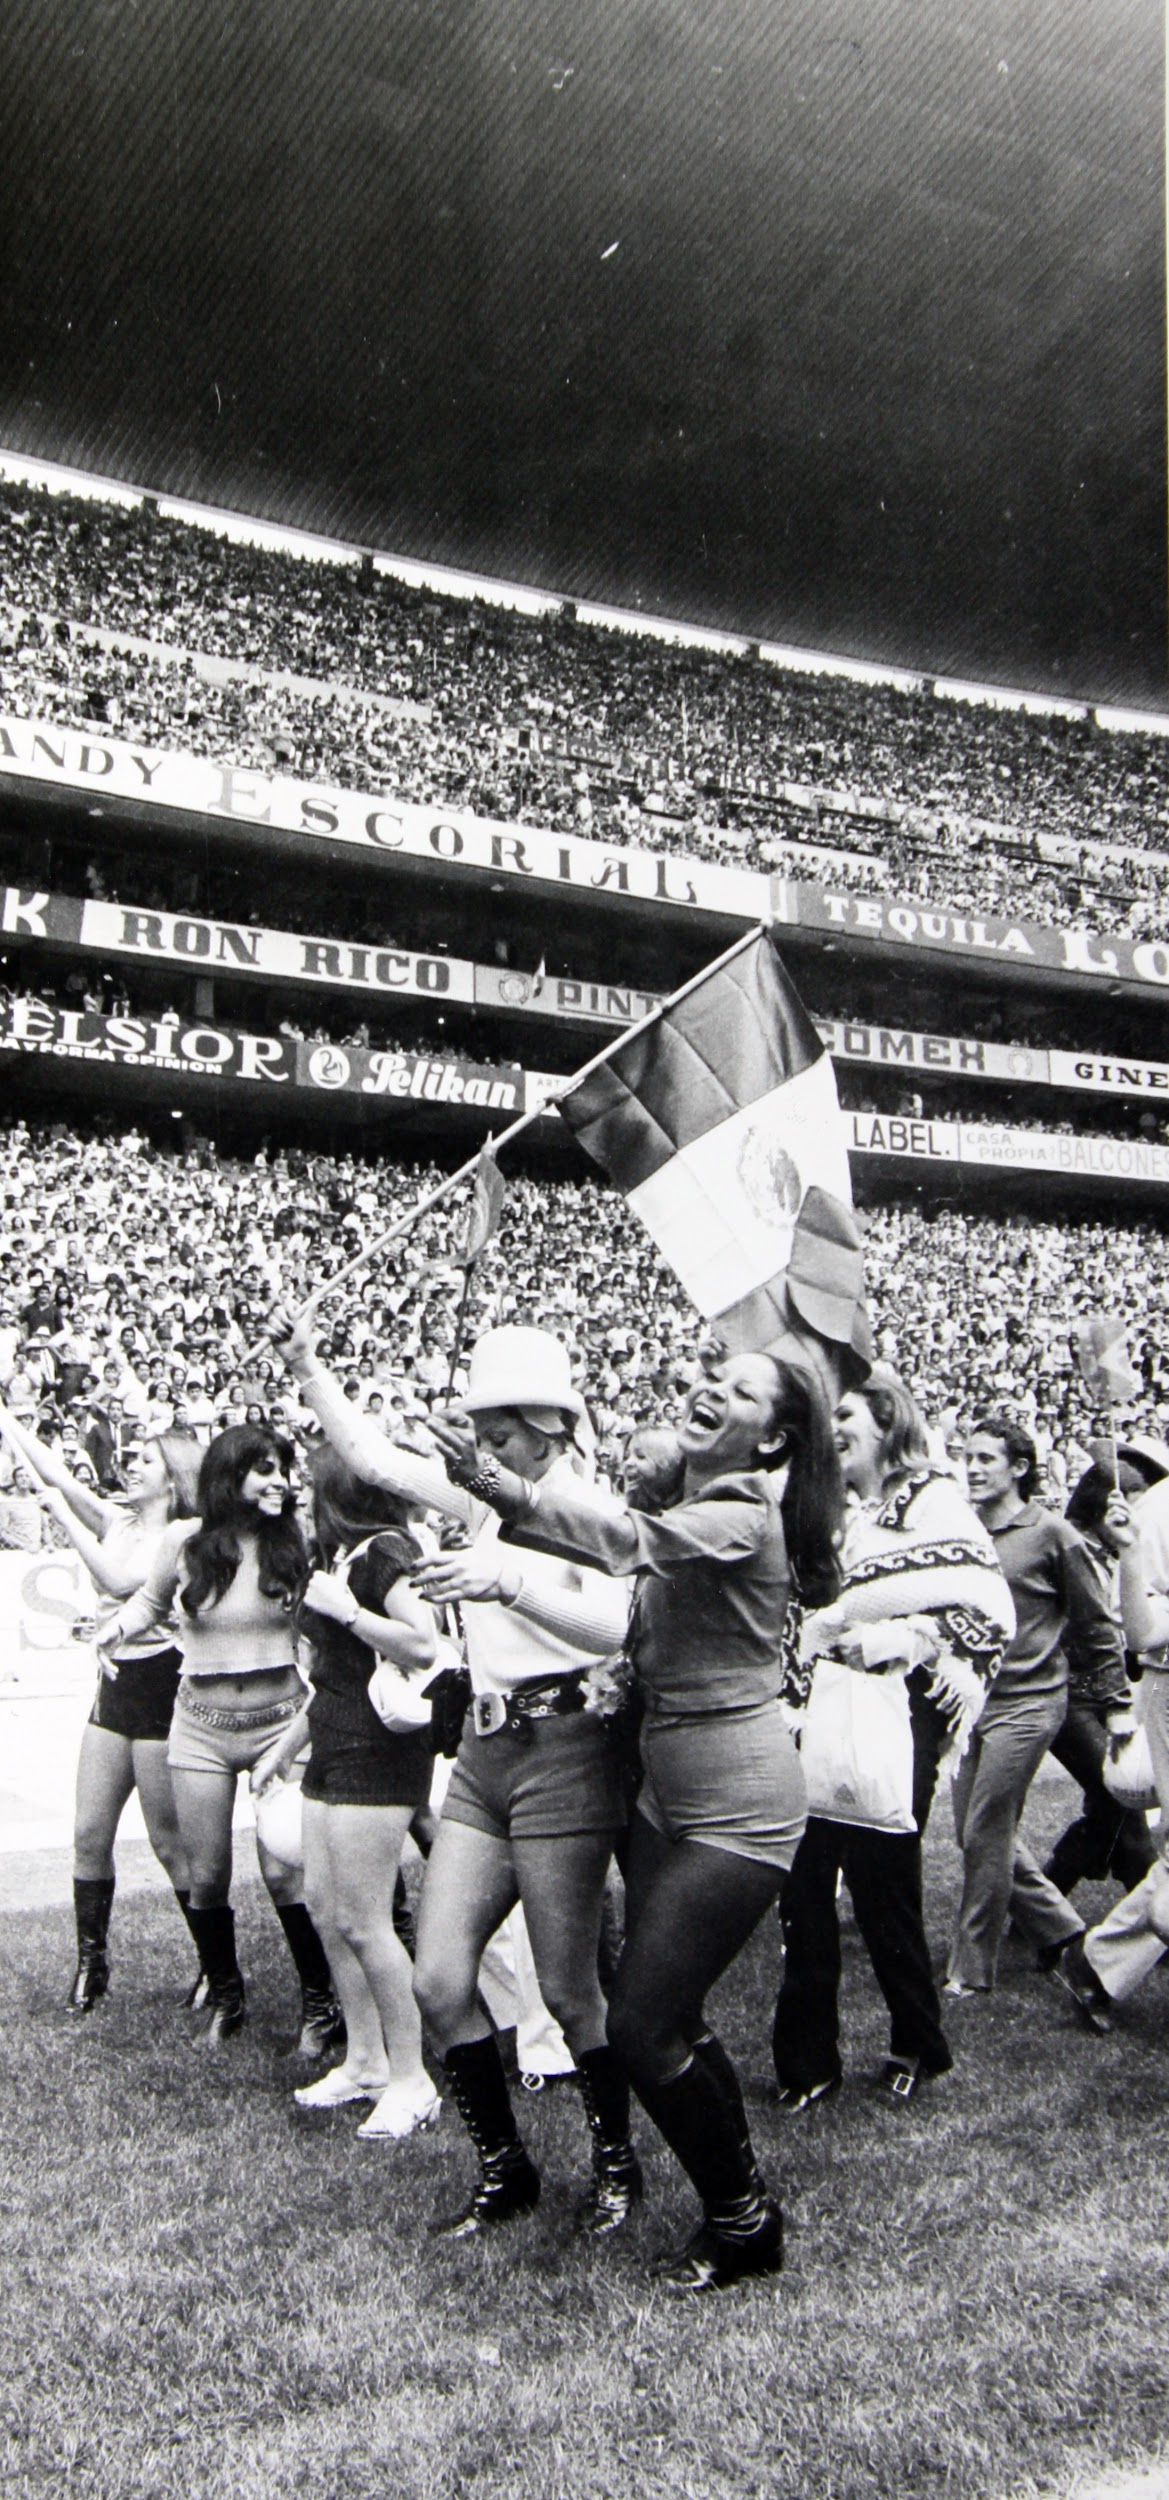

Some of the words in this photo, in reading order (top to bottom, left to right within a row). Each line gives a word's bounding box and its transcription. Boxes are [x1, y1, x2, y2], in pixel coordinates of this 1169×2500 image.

[207, 763, 697, 905] ESCORIAL
[2, 887, 49, 936] K
[118, 911, 262, 965] RON
[299, 942, 450, 993] RICO
[824, 895, 1036, 955] TEQUILA
[1058, 928, 1169, 984] LO
[0, 1000, 289, 1083] ELSIOR
[123, 1053, 223, 1075] OPINION
[361, 1053, 517, 1110] Pelikan
[1075, 1062, 1169, 1089] GINE
[853, 1115, 950, 1155] LABEL.
[966, 1132, 1012, 1145] CASA
